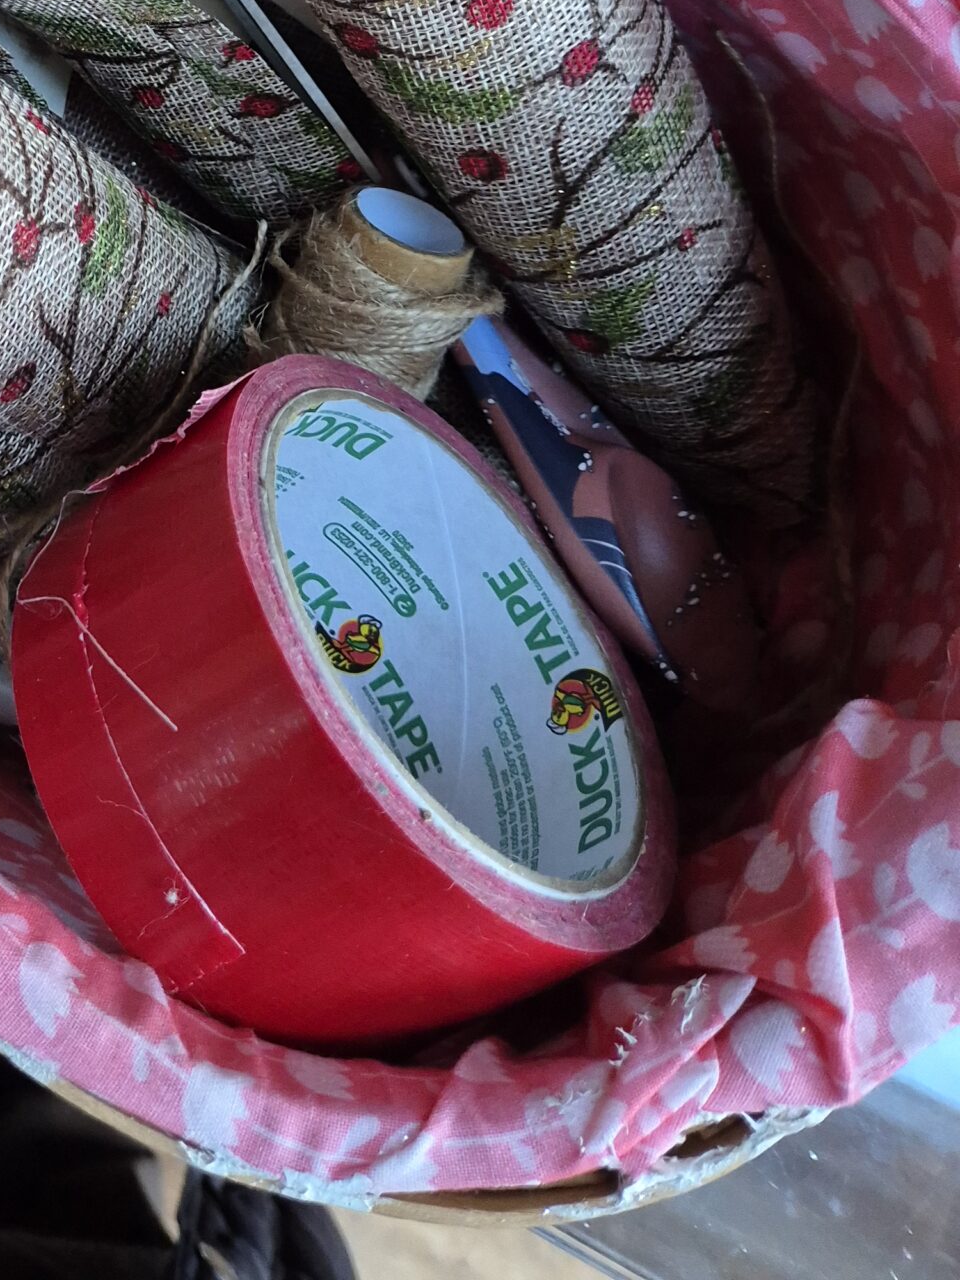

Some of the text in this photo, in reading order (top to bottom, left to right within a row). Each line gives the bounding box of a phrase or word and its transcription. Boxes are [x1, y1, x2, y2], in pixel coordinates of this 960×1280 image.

[283, 414, 387, 461] DUCK
[286, 549, 353, 627] UCK
[330, 527, 399, 596] 1-800-321-0253
[350, 520, 422, 595] DuckBrand.com
[487, 561, 572, 686] TAPE
[368, 658, 441, 780] TAPE
[567, 726, 614, 855] DUCK
